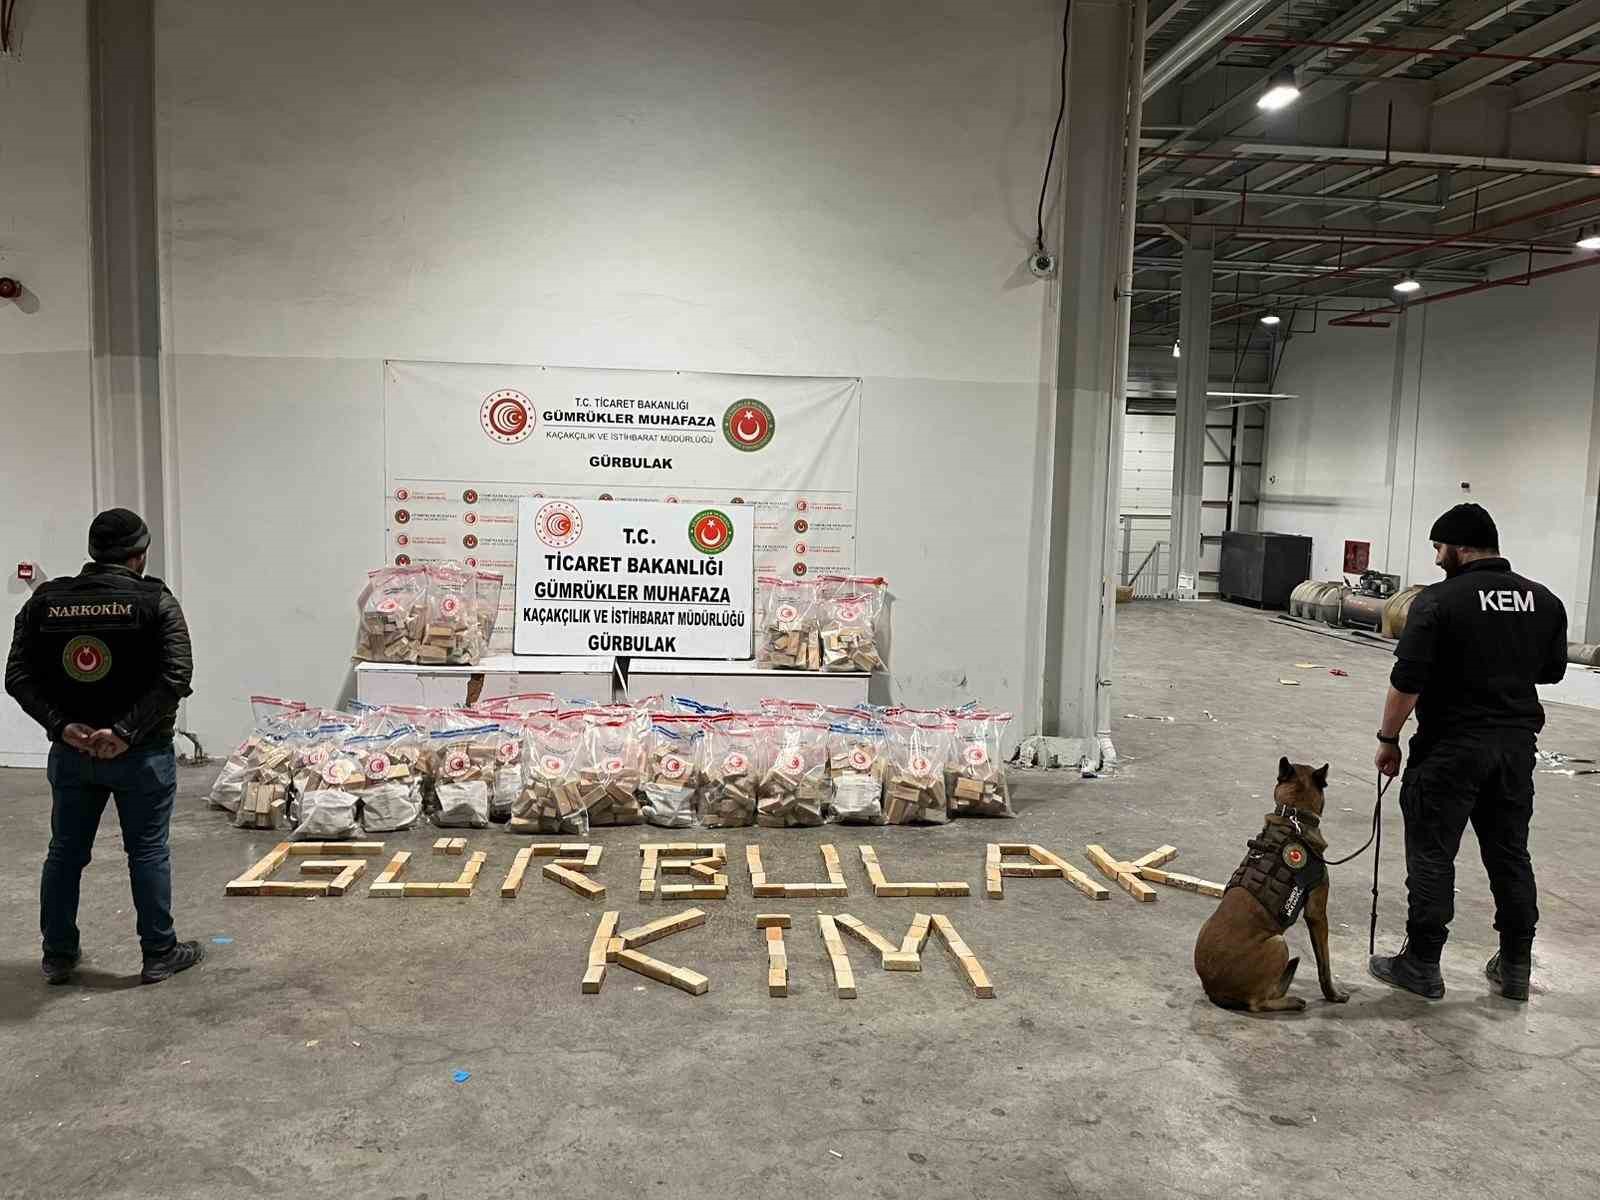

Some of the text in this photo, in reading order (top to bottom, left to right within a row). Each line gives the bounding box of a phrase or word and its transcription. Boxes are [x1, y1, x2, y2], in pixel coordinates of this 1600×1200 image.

[575, 396, 690, 411] T.C. TİCARET BAKANLIĞI
[542, 409, 716, 427] GÜMRÜKLER MUHAFAZA
[546, 431, 714, 444] KAÇAKÇILIK VE İSTİHBARAT MÜDÜRLÜĞÜ
[589, 454, 673, 470] GÜRBULAK
[622, 528, 656, 545] T.C.
[544, 551, 723, 576] TİCARET BAKANLIĞI
[534, 578, 731, 603] GÜMRÜKLER MUHAFAZA
[48, 601, 133, 617] NARKOKİM
[1478, 590, 1536, 612] KEM
[523, 606, 745, 628] KAÇAKÇILIK VE İSTİHBARAT MÜDÜRLÜĞÜ
[588, 632, 677, 653] GÜRBULAK
[224, 837, 1226, 902] GÜRBULAK
